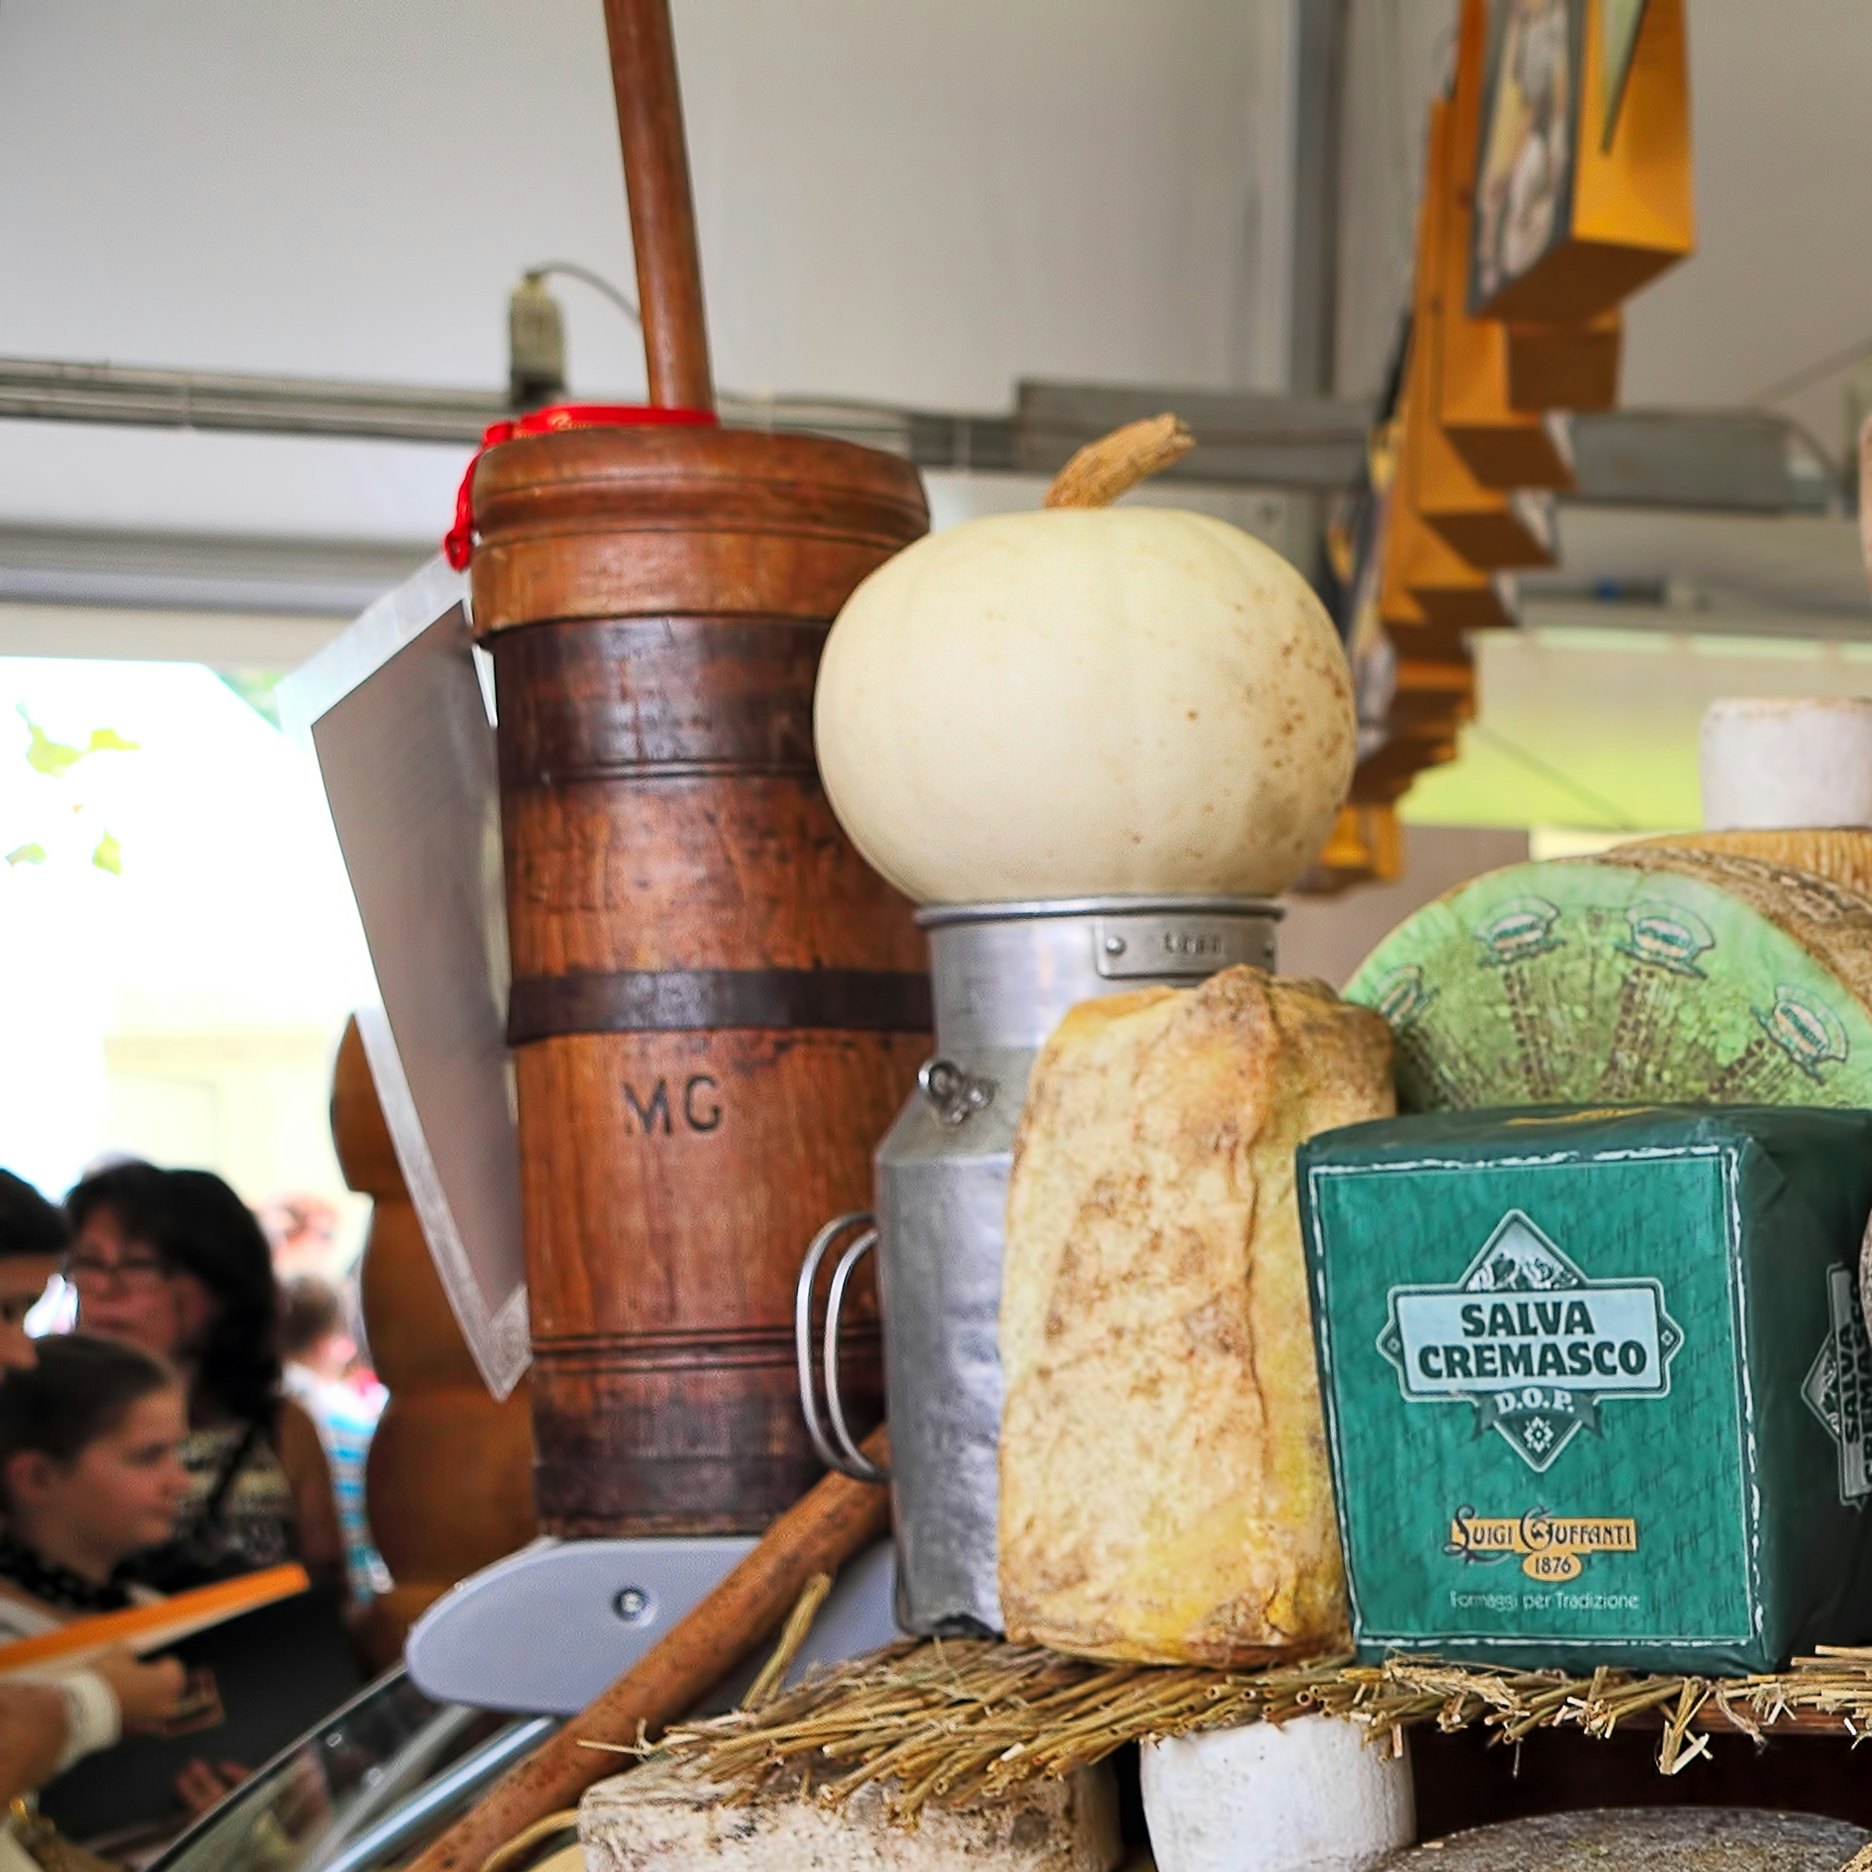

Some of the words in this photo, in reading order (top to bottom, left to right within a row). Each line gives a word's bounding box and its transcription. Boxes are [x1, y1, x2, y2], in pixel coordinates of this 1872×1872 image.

[1461, 1301, 1595, 1338] SALVA
[1418, 1340, 1647, 1379] CREMASCO
[1839, 1322, 1860, 1445] SALVA
[1494, 1387, 1575, 1414] D.O.P.
[1534, 1556, 1572, 1574] 1876
[1450, 1591, 1518, 1612] Formaggi
[1523, 1594, 1550, 1611] per
[1556, 1592, 1640, 1610] Tradizione
